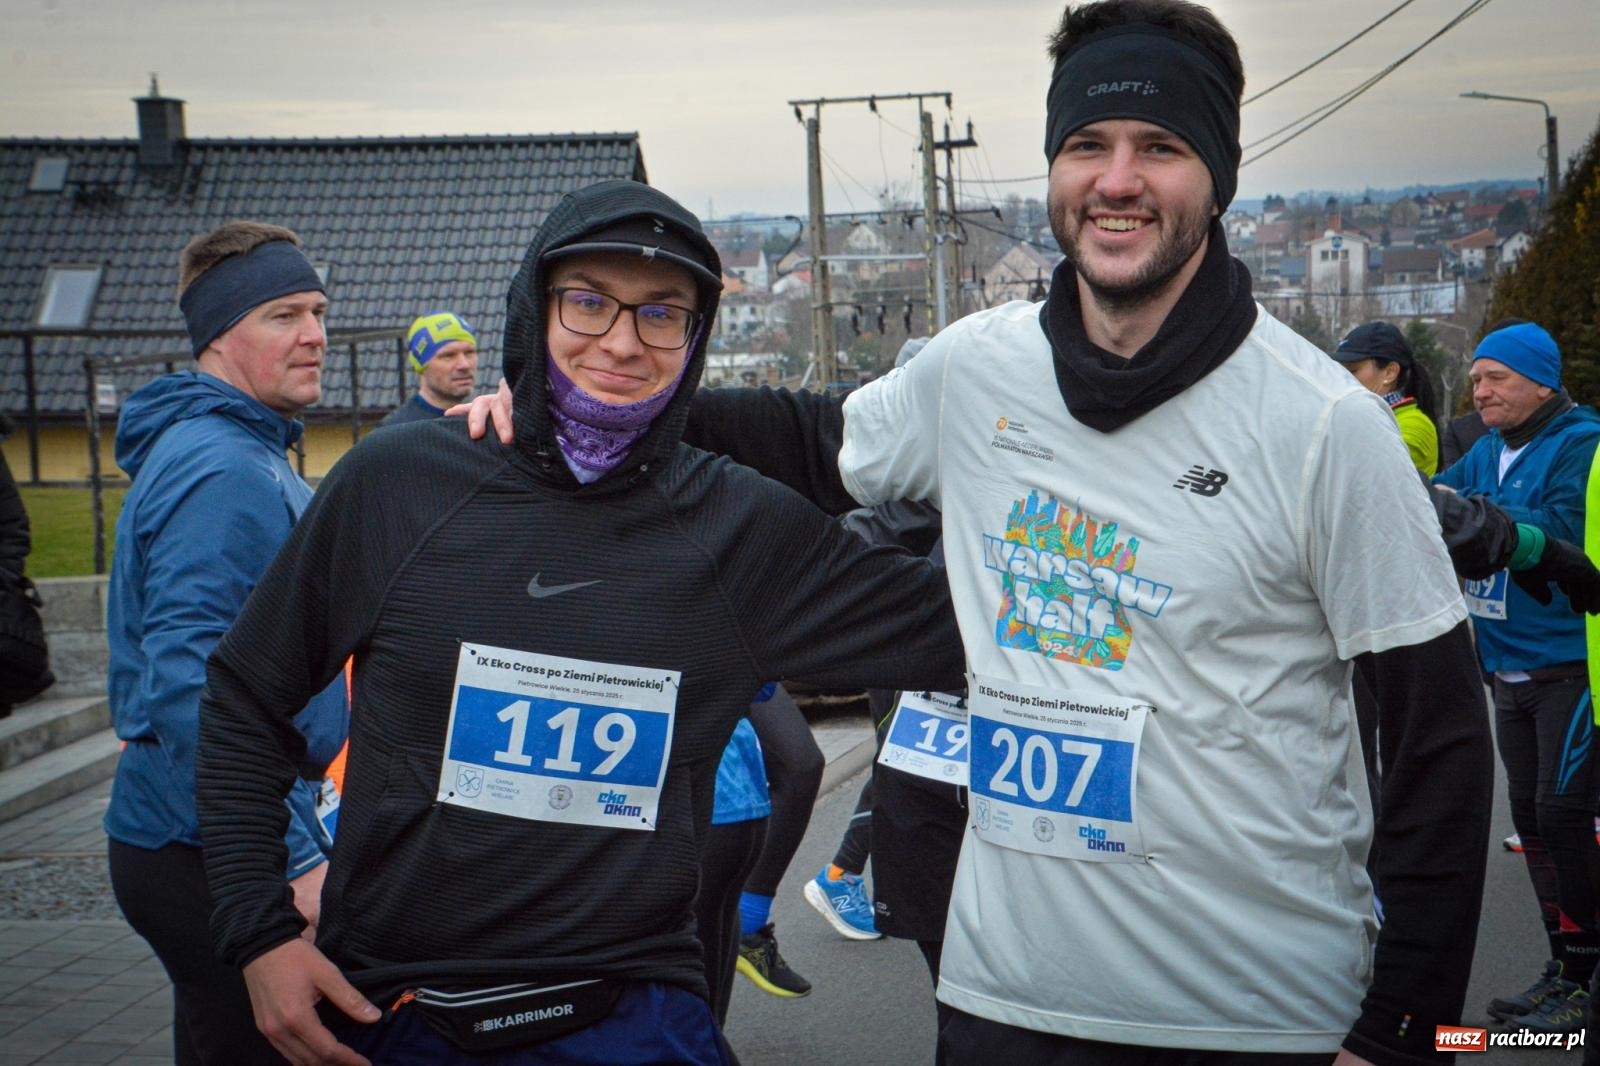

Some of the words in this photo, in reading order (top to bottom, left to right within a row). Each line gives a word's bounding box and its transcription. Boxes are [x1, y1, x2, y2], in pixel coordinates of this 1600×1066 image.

[1087, 80, 1143, 96] CRAFT
[1014, 577, 1116, 640] half
[476, 656, 489, 666] IX
[490, 658, 511, 669] Eko
[513, 662, 545, 675] Cross
[547, 668, 561, 678] po
[563, 669, 595, 682] Ziemi
[596, 673, 665, 692] Pietrowickiej
[979, 685, 986, 695] IX
[986, 687, 998, 698] Eko
[998, 690, 1019, 703] Cross
[1020, 697, 1031, 706] po
[1031, 696, 1059, 709] Ziemi
[1060, 700, 1130, 721] Pietrowickiej
[494, 699, 637, 776] 119
[989, 727, 1102, 807] 207
[597, 789, 627, 804] eko
[1079, 823, 1106, 839] eko
[492, 1004, 574, 1030] KARRIMOR
